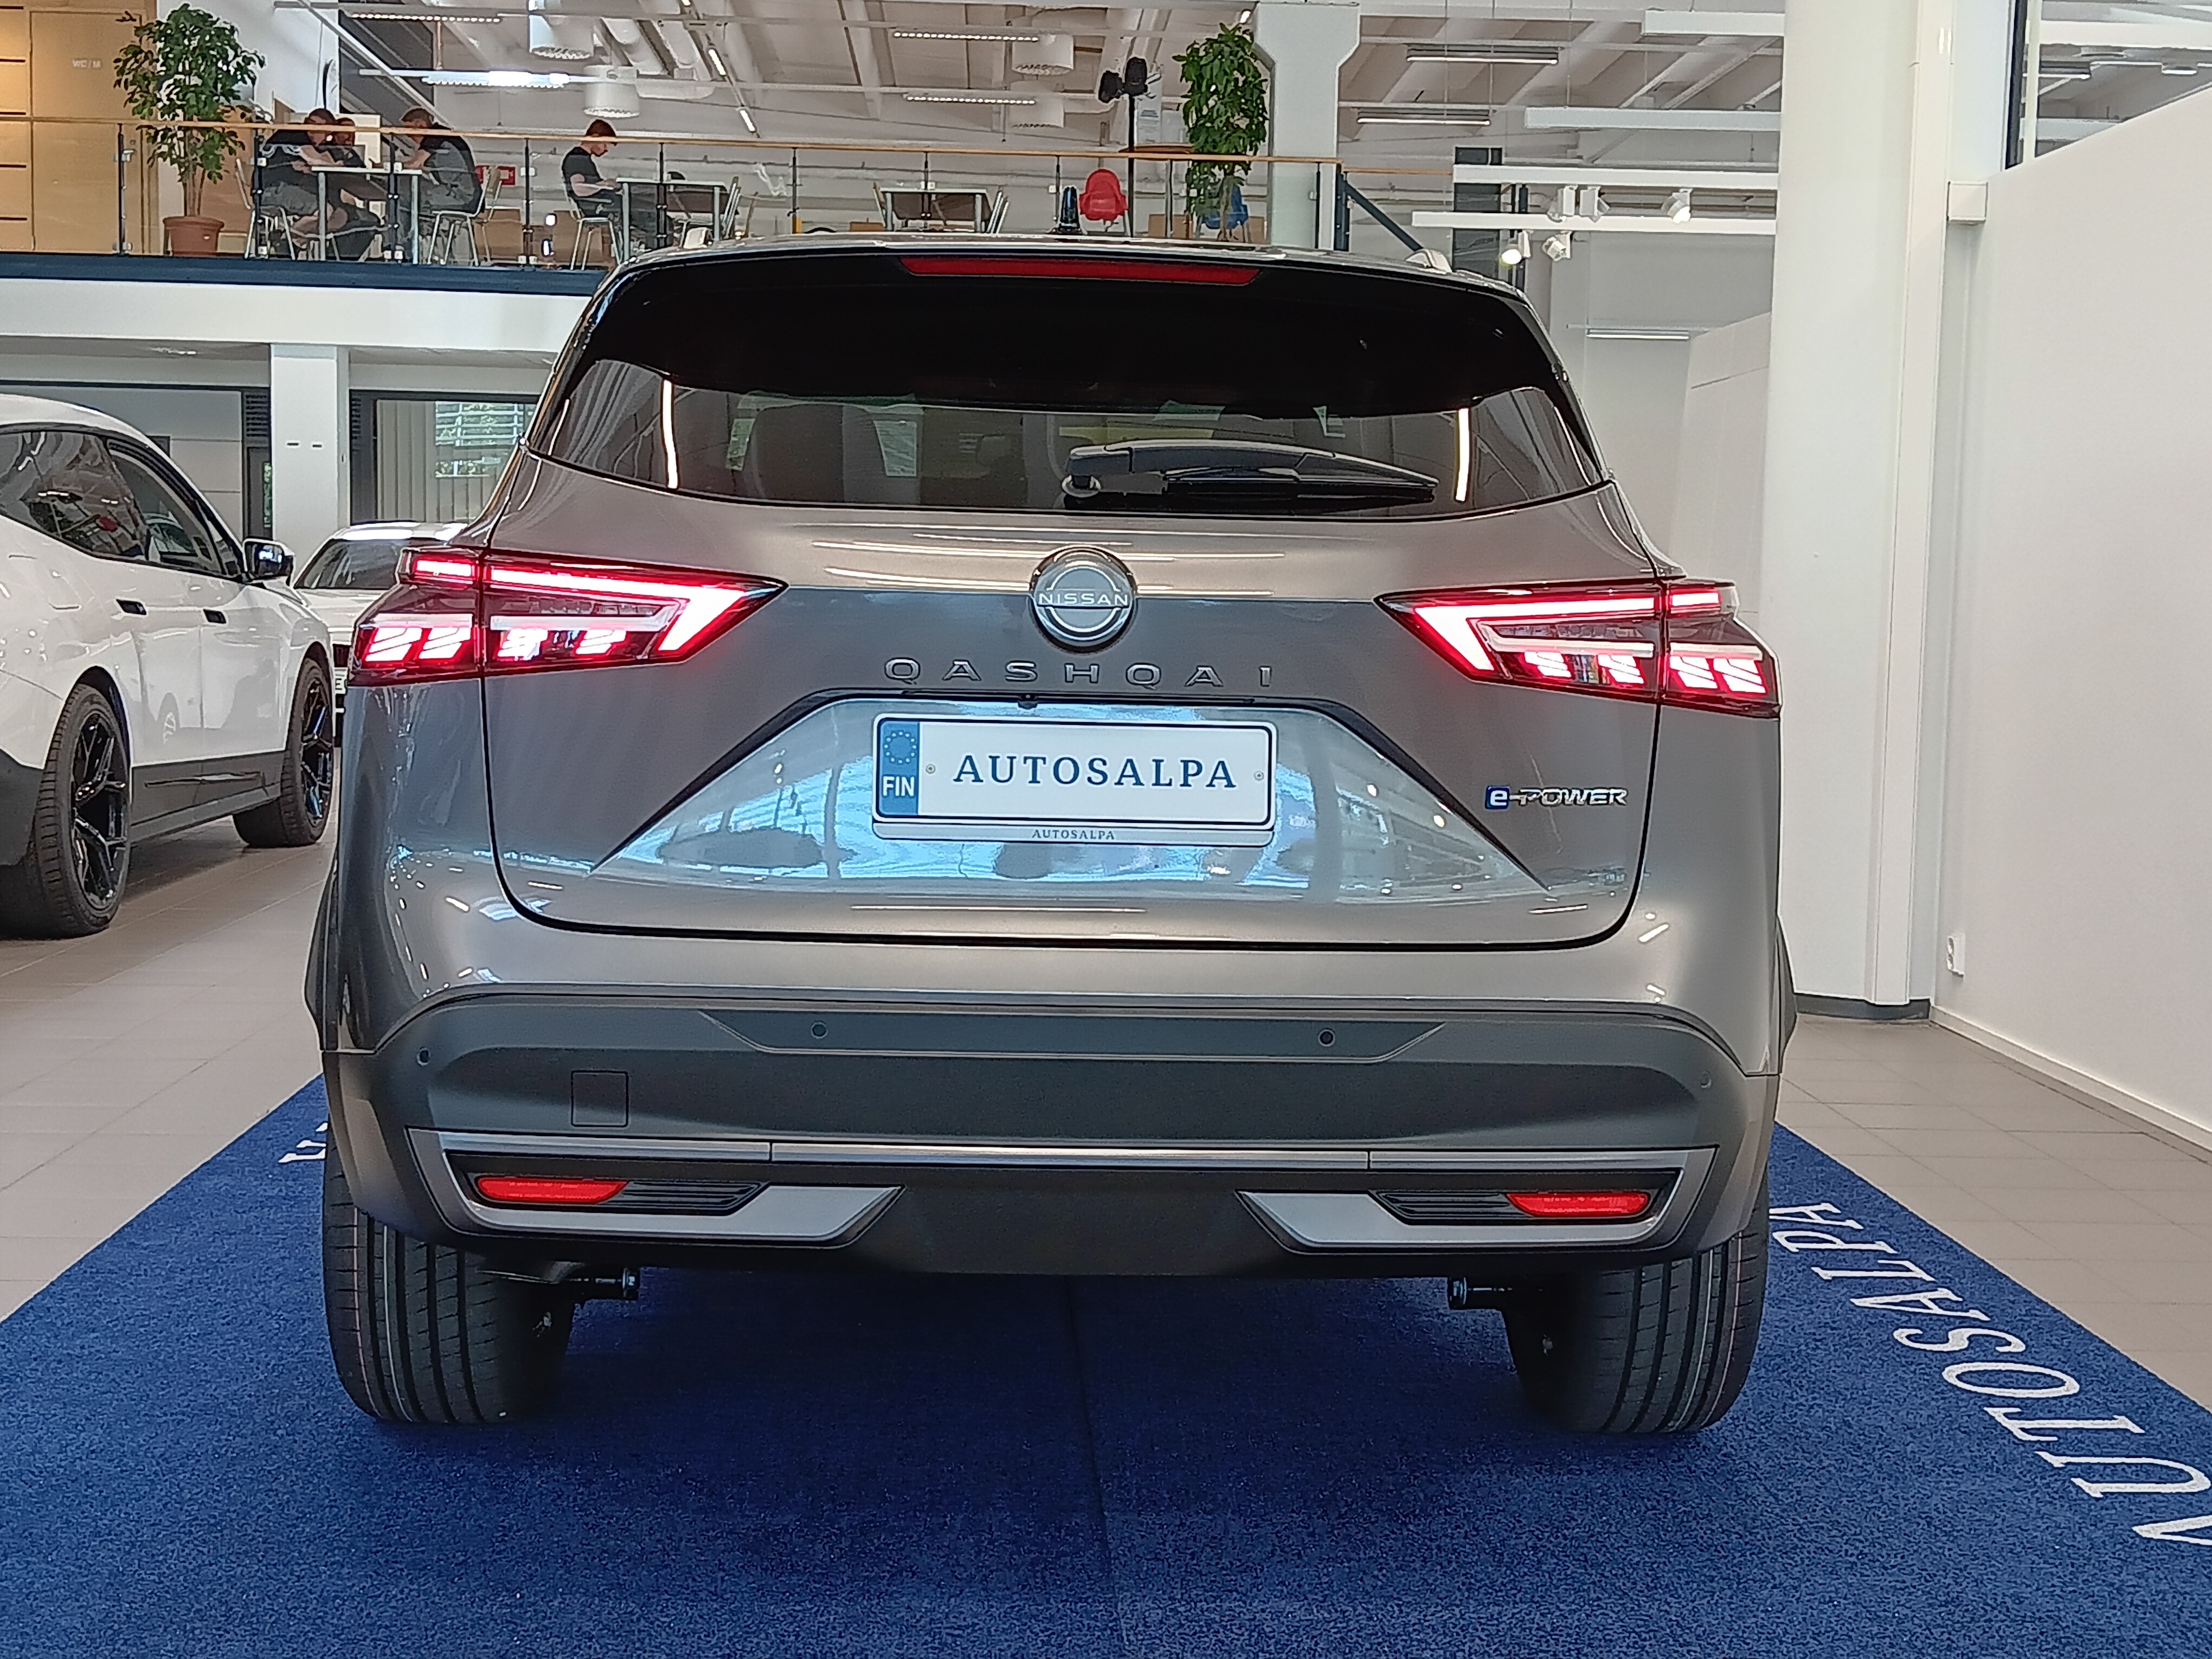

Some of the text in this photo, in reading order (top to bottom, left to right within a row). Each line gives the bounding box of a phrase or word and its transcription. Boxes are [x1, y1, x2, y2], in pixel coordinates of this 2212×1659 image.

[1039, 593, 1128, 607] NISSAN
[884, 658, 1273, 690] QASHQAI
[953, 755, 1237, 789] AUTOSALPA
[883, 776, 915, 798] FIN
[1489, 787, 1628, 807] e-POWER
[1032, 829, 1115, 840] AUTOSALPA
